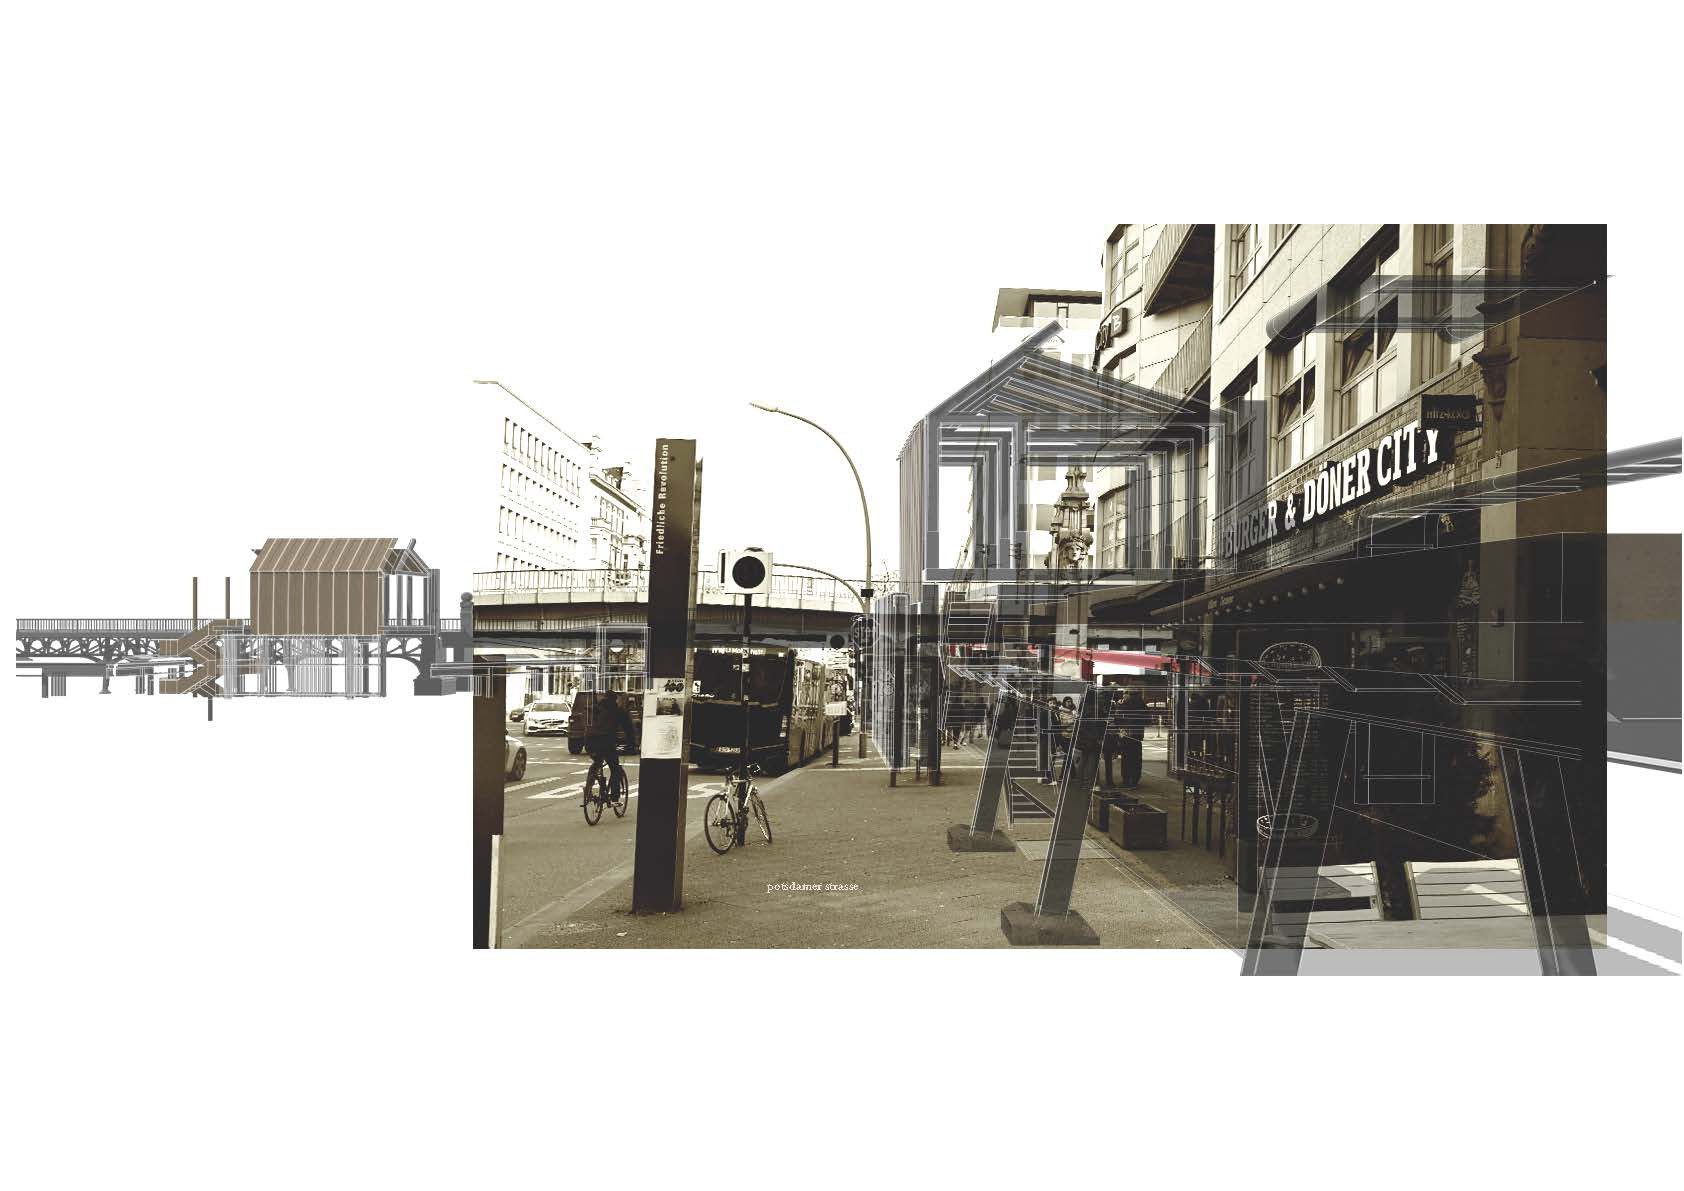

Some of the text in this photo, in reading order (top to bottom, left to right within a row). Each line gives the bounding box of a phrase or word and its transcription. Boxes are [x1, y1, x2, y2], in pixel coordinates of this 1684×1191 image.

[655, 444, 669, 555] Friedliche Revolution
[1224, 423, 1440, 558] BURGER & DÖNER CITY
